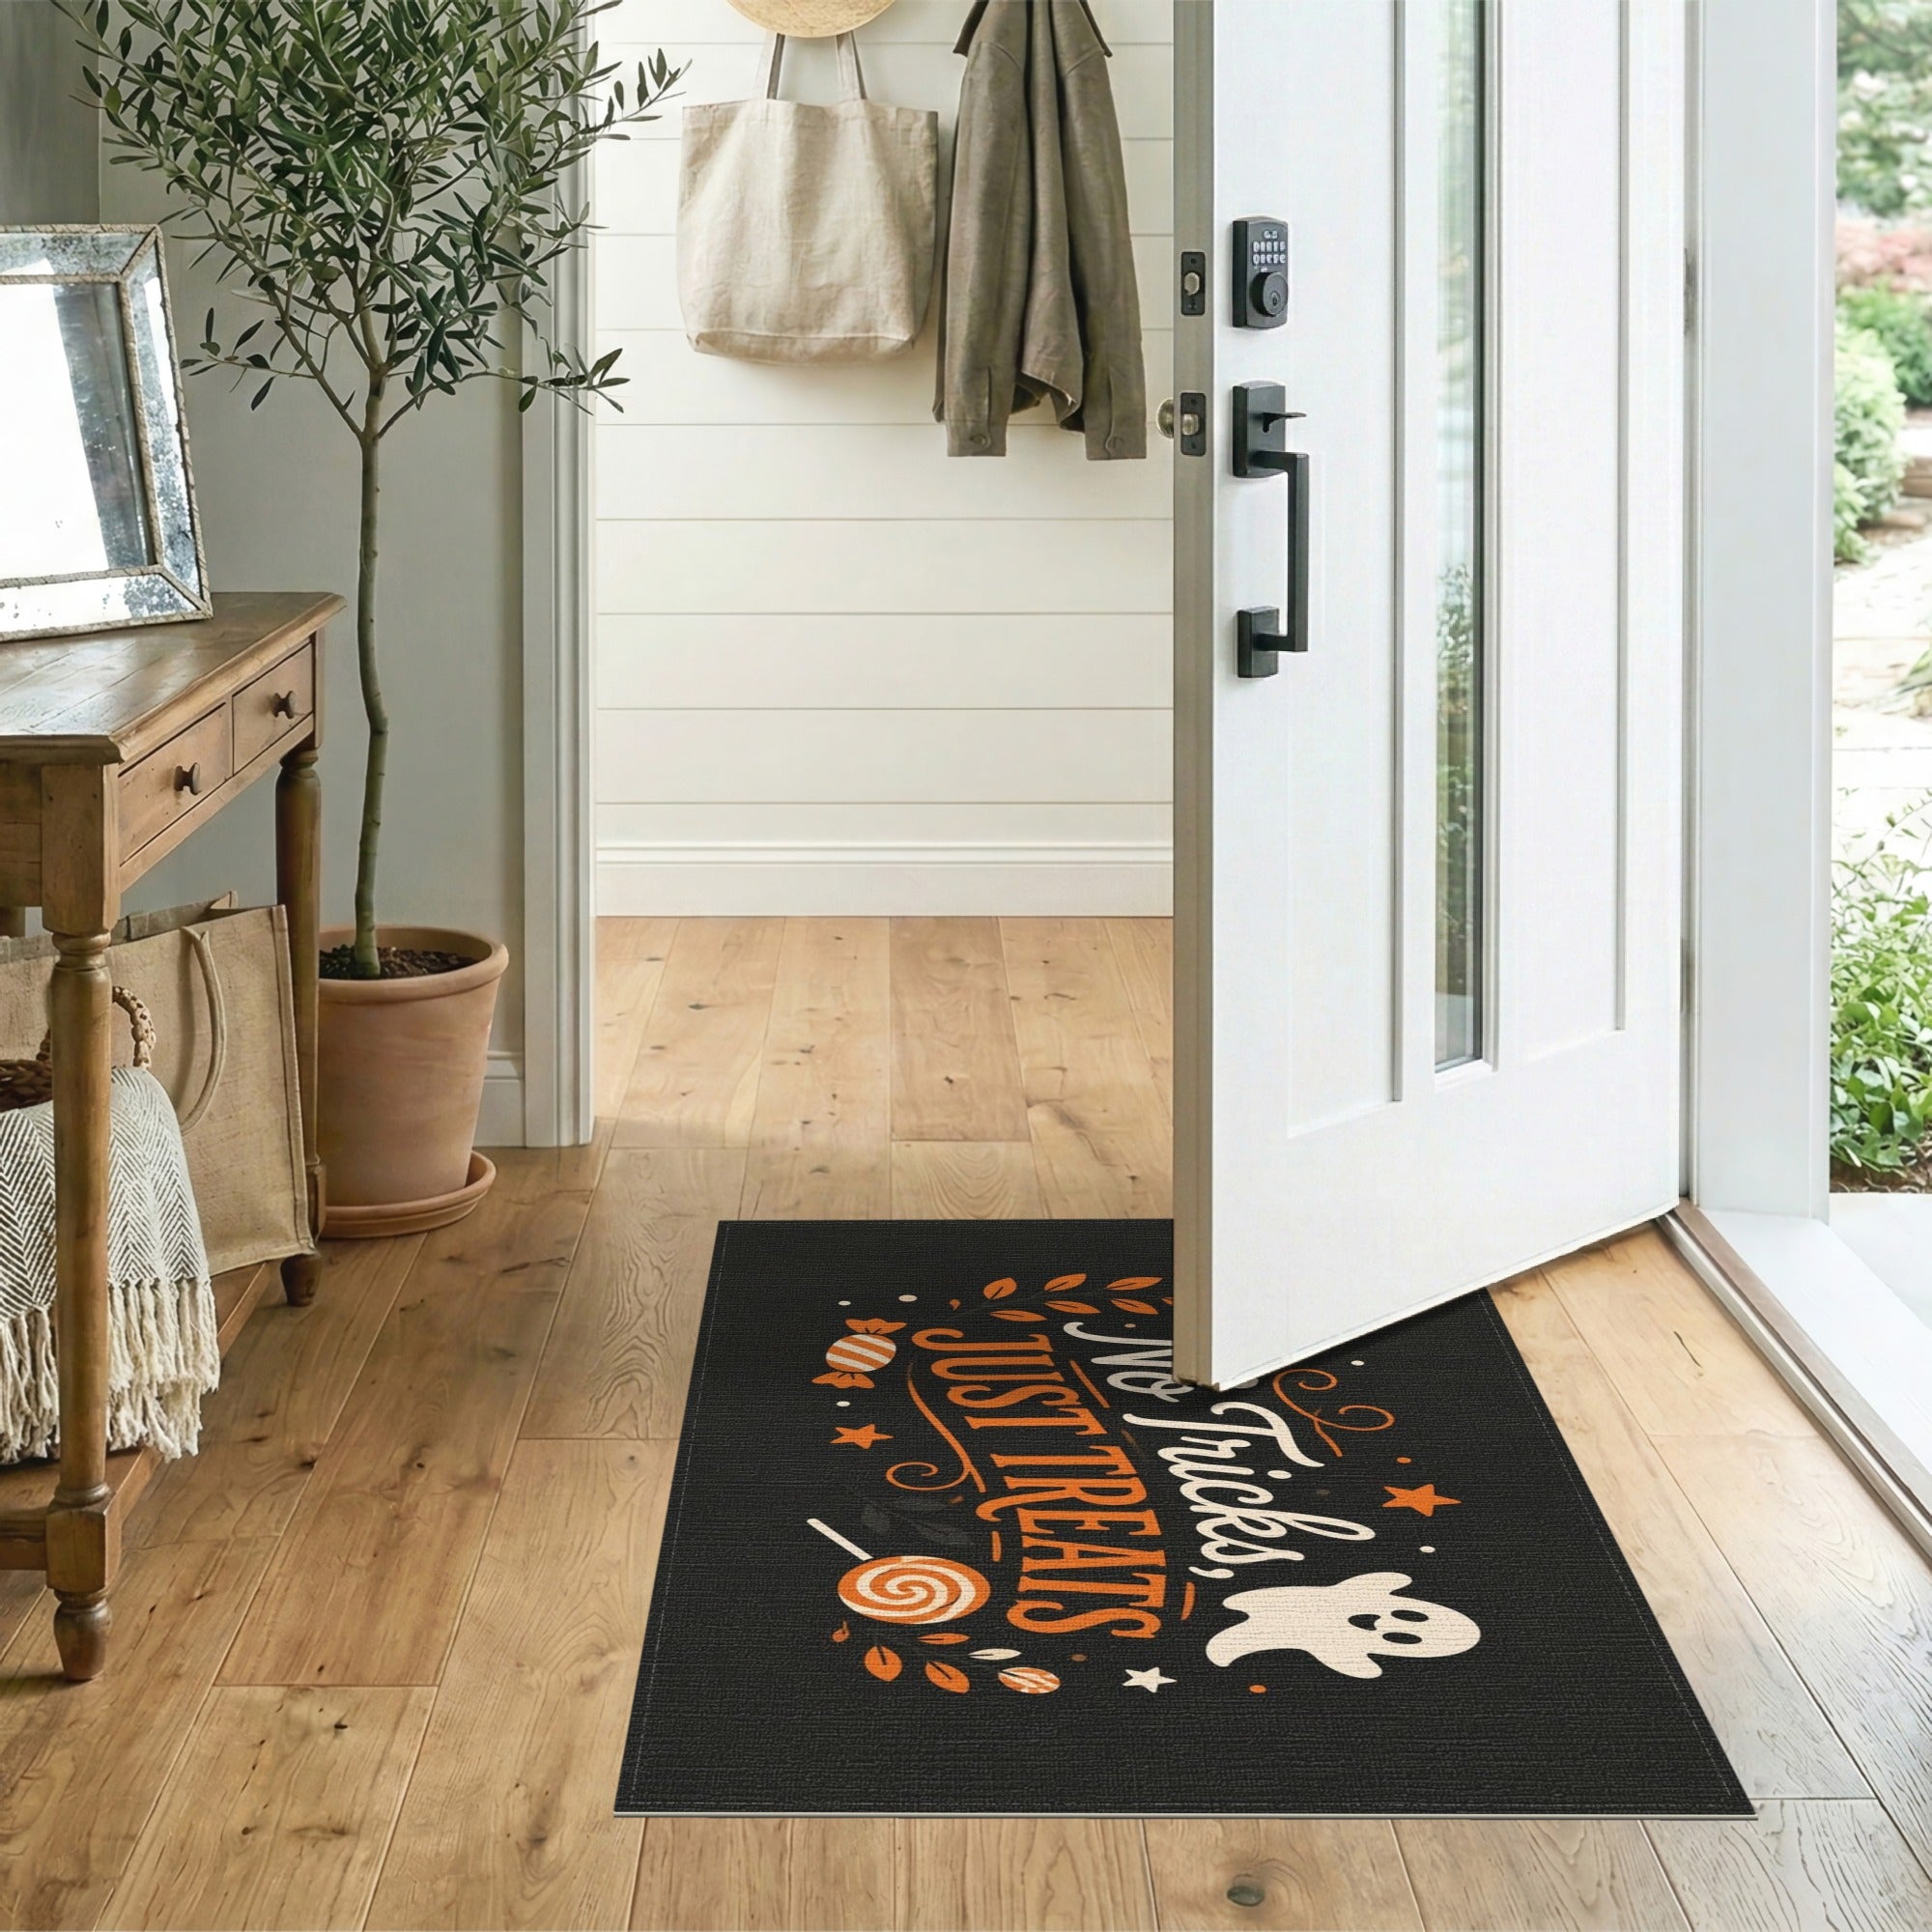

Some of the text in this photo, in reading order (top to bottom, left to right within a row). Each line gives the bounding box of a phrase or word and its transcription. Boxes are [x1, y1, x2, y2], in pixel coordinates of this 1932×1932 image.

[911, 1327, 1167, 1639] JUST TREATS
[1122, 1401, 1377, 1579] Tricks,
